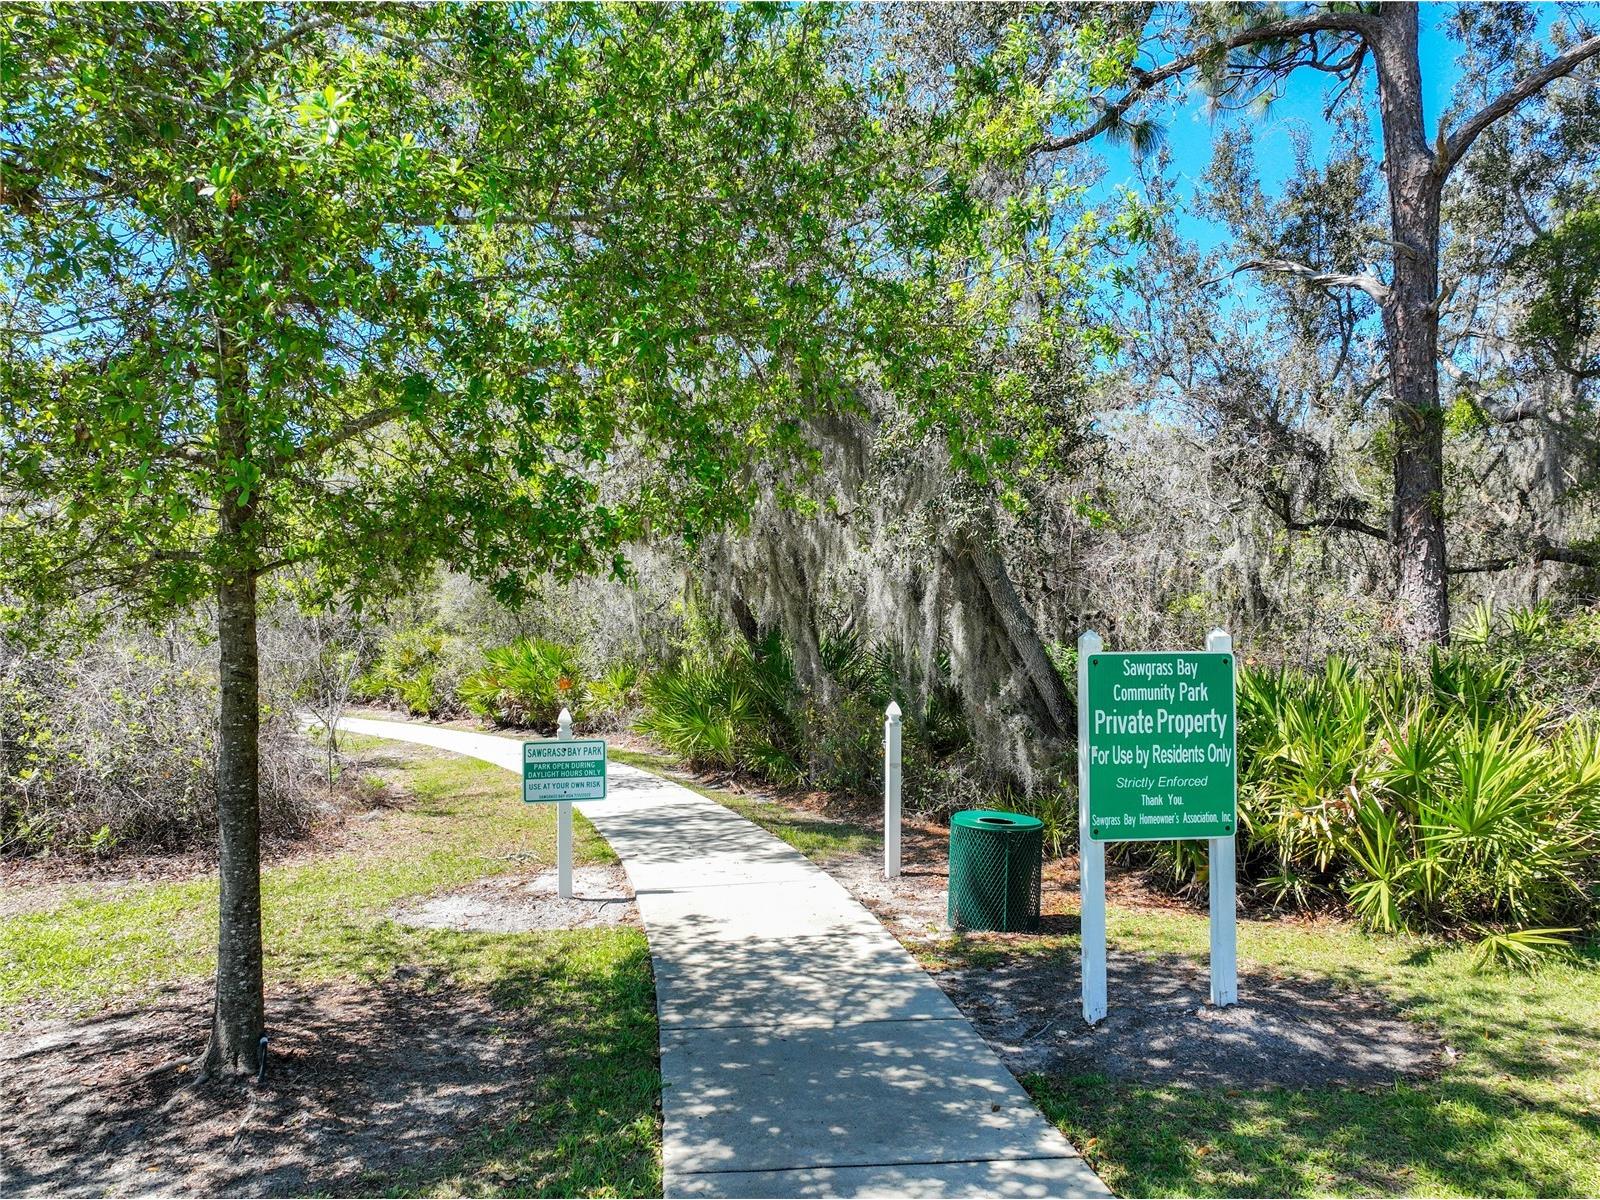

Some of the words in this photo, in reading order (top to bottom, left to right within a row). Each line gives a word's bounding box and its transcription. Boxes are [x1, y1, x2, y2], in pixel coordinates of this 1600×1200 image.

[1123, 659, 1173, 680] Sawgrass
[1177, 659, 1198, 680] Bay
[1114, 684, 1175, 704] Community
[1180, 682, 1208, 702] Park
[1095, 709, 1153, 734] Private
[1158, 708, 1227, 738] Property
[528, 748, 566, 758] SAWGRASS
[568, 748, 582, 756] BAY
[584, 746, 602, 755] PARK
[1092, 746, 1110, 764] For
[1112, 745, 1133, 764] Use
[1136, 745, 1149, 768] by
[1152, 744, 1205, 764] Residents
[1208, 744, 1232, 767] Only
[1116, 777, 1154, 790] Strictly
[1158, 776, 1208, 788] Enforced
[1142, 794, 1163, 806] Thank
[1168, 794, 1184, 805] You.
[1092, 814, 1120, 829] Sawgrass
[1124, 814, 1136, 828] Bay
[1140, 813, 1180, 824] Homeowner's
[1183, 812, 1218, 824] Association,
[1222, 812, 1232, 822] Inc.
